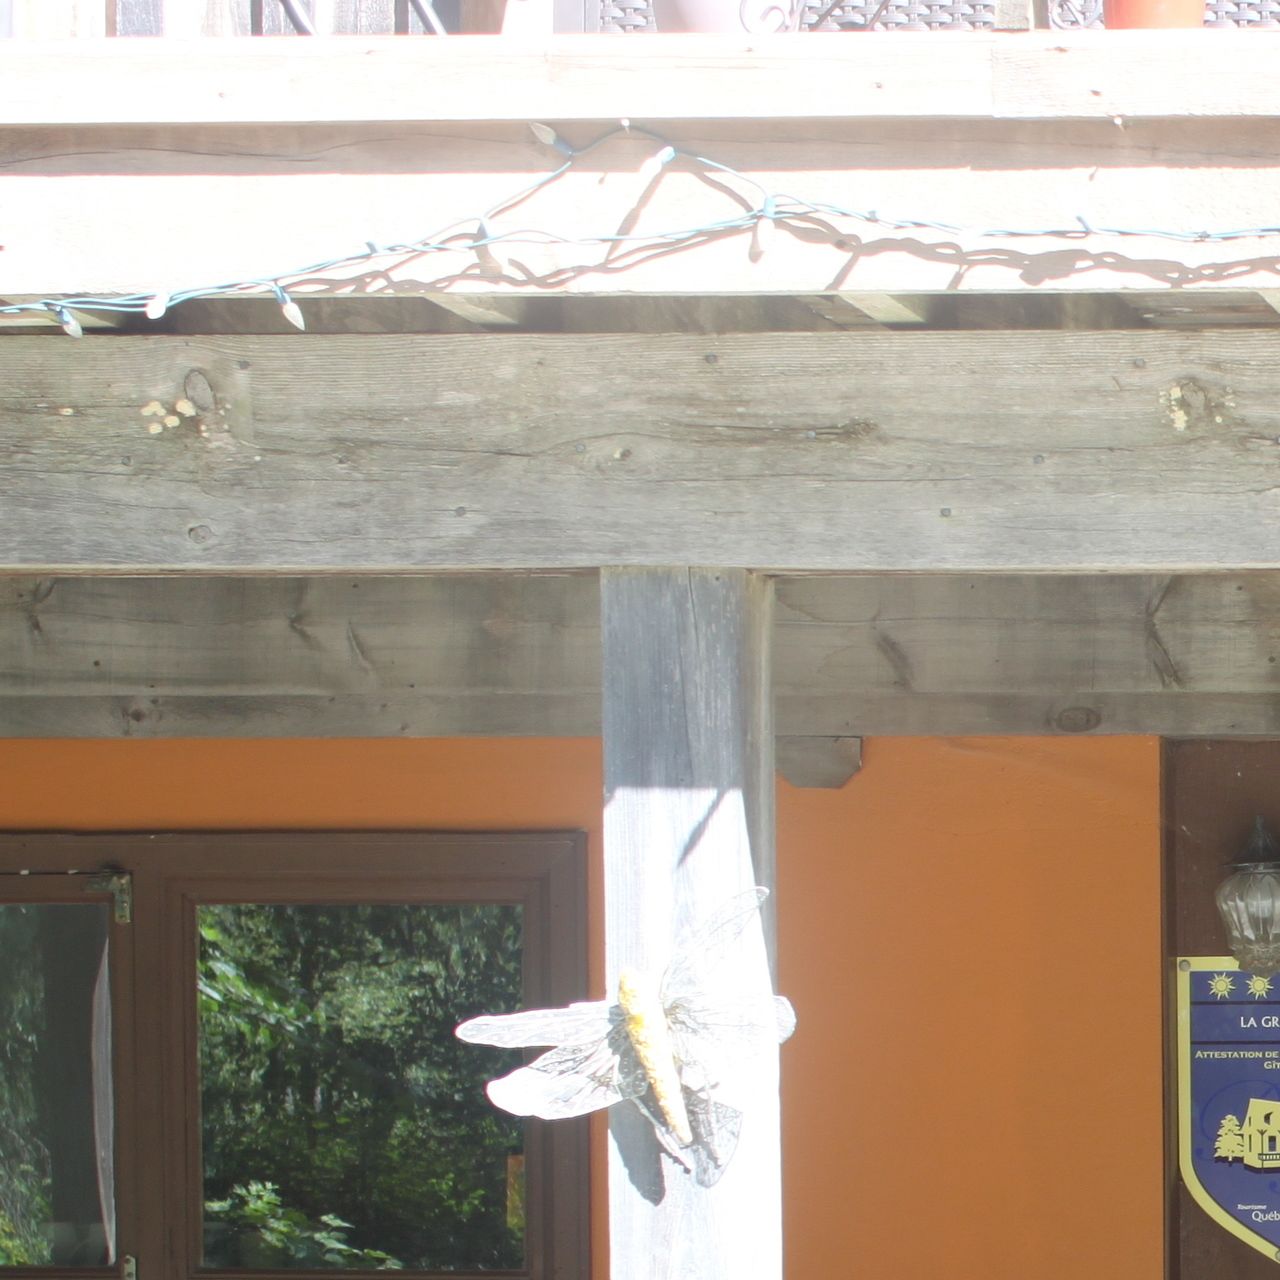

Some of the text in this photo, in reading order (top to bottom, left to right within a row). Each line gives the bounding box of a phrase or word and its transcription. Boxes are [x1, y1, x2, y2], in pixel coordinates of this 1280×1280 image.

[1240, 1016, 1257, 1028] LA
[1195, 1050, 1263, 1059] ATTESTATION
[1265, 1051, 1279, 1059] DE
